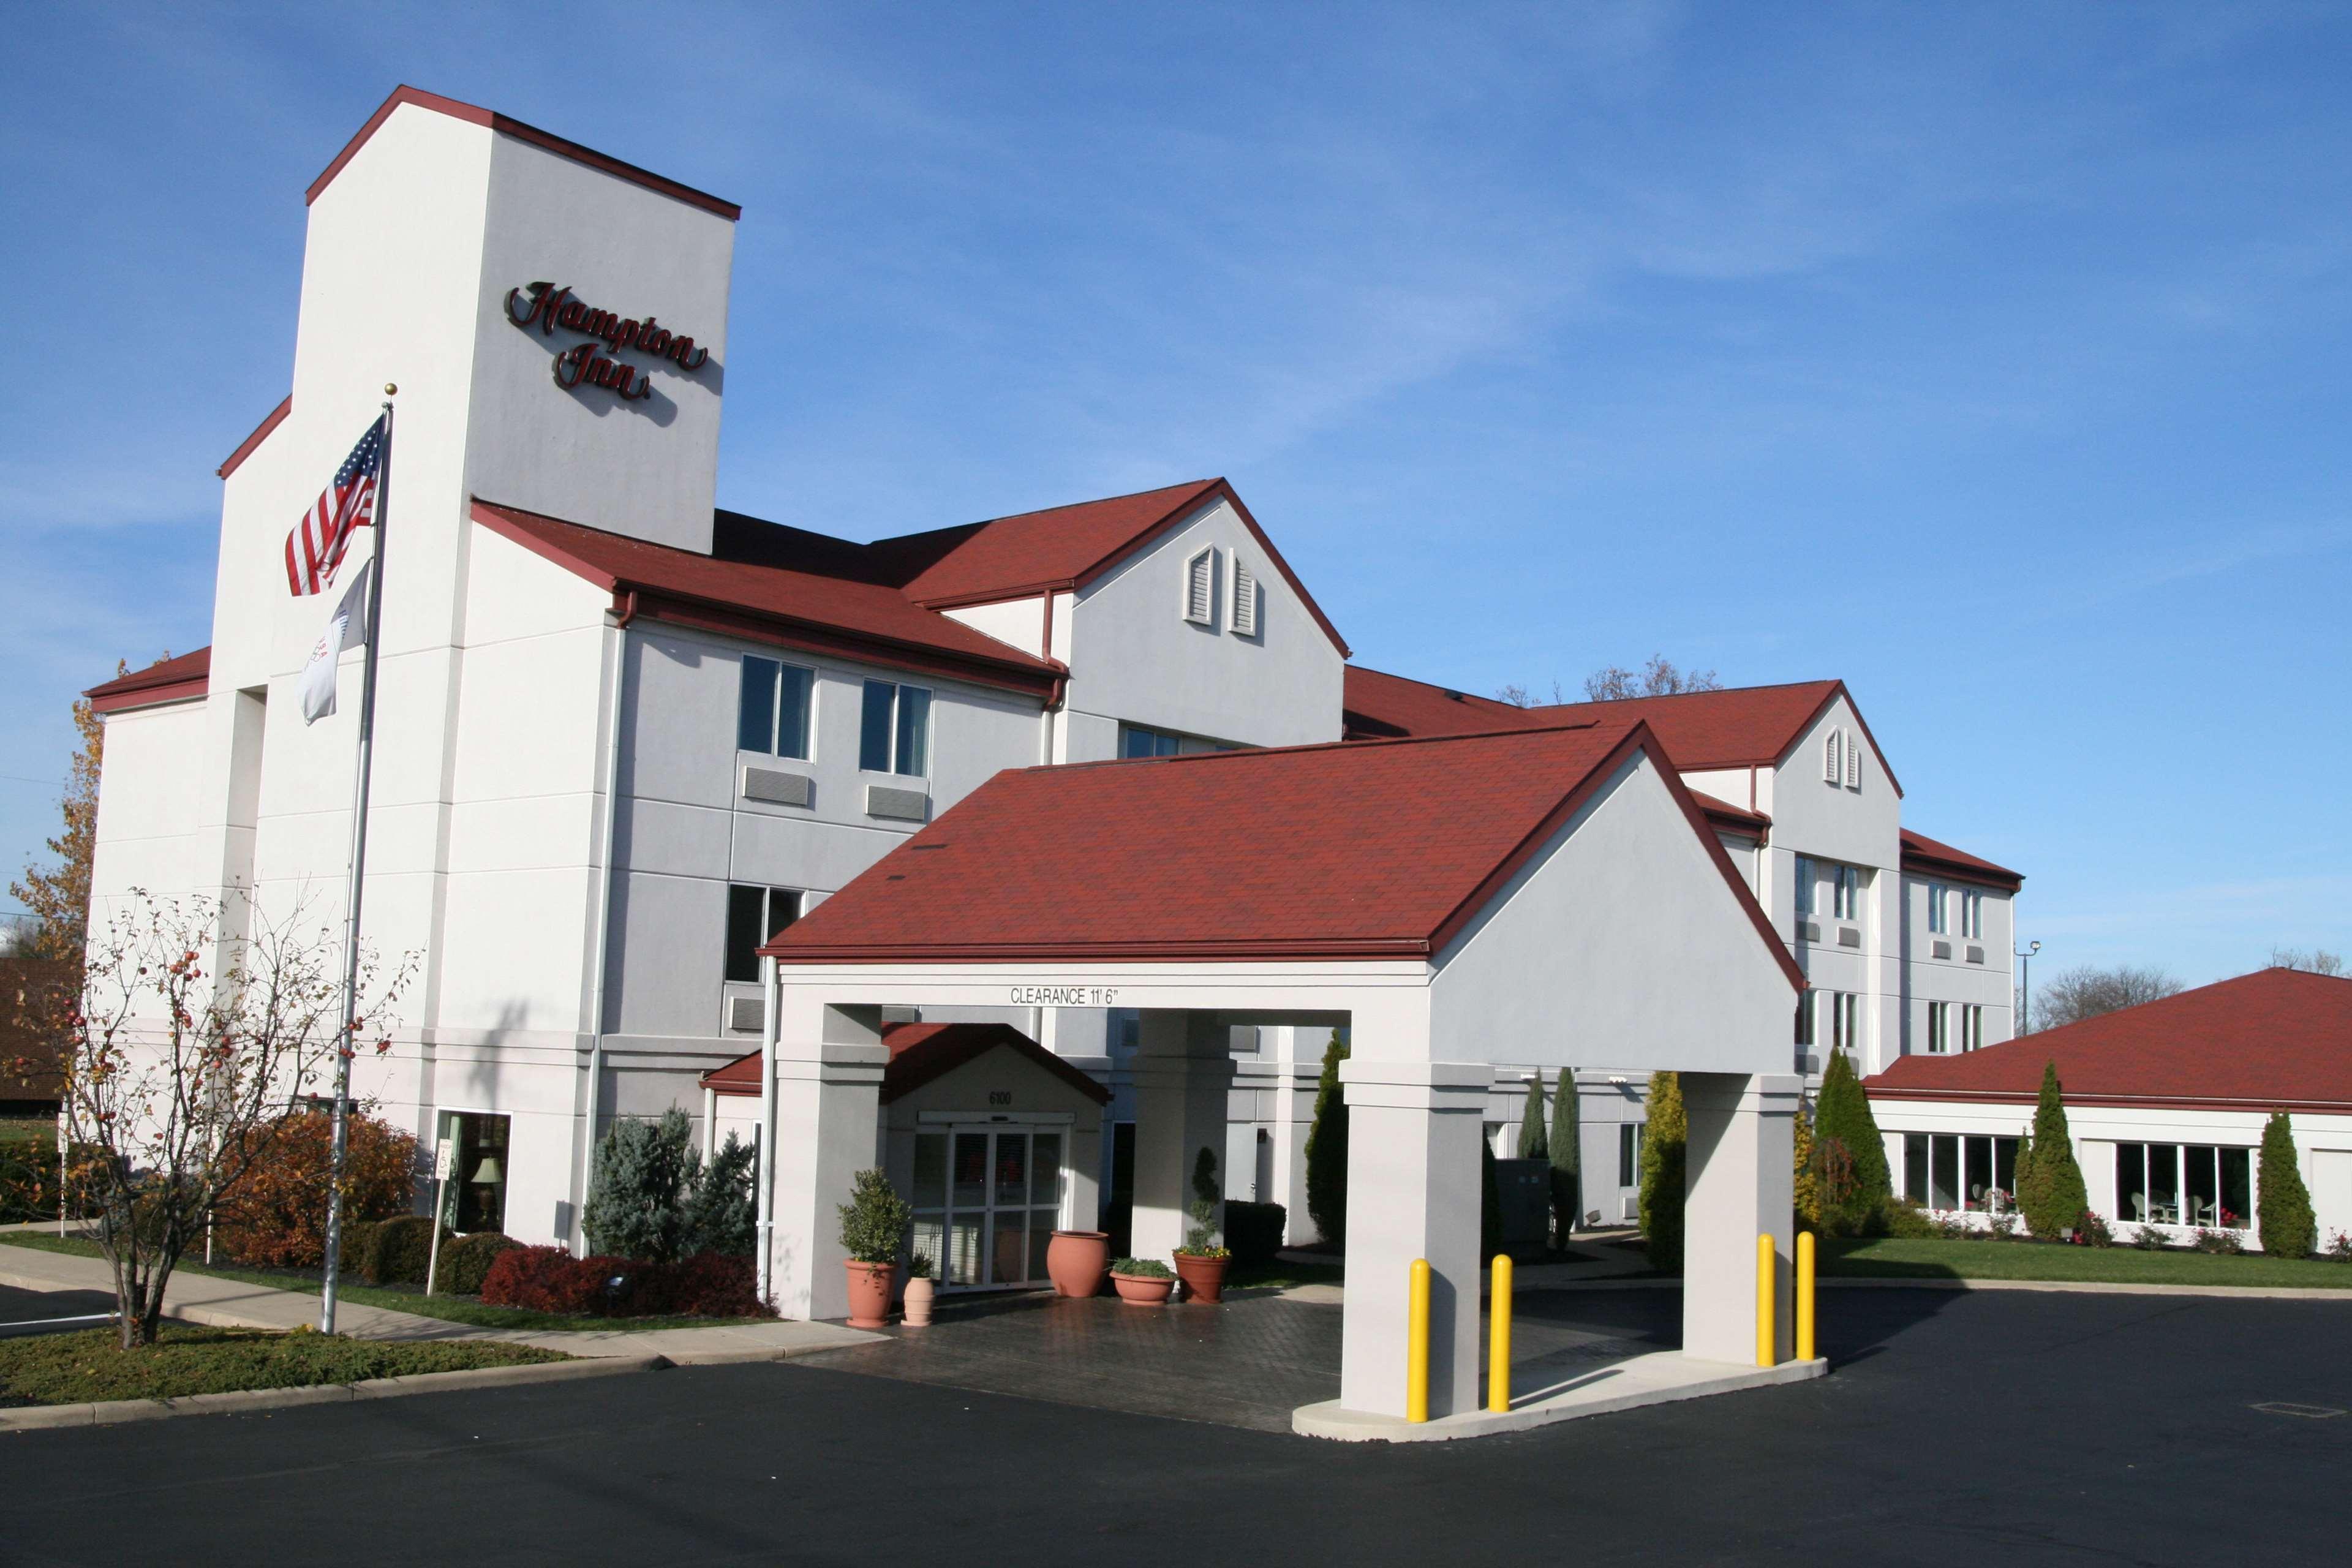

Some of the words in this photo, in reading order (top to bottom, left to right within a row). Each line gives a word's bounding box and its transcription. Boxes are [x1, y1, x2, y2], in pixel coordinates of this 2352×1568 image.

[505, 281, 709, 371] Hampton
[554, 343, 650, 401] Inn
[1011, 987, 1085, 1005] CLEARANCE
[989, 1091, 1011, 1105] 6100
